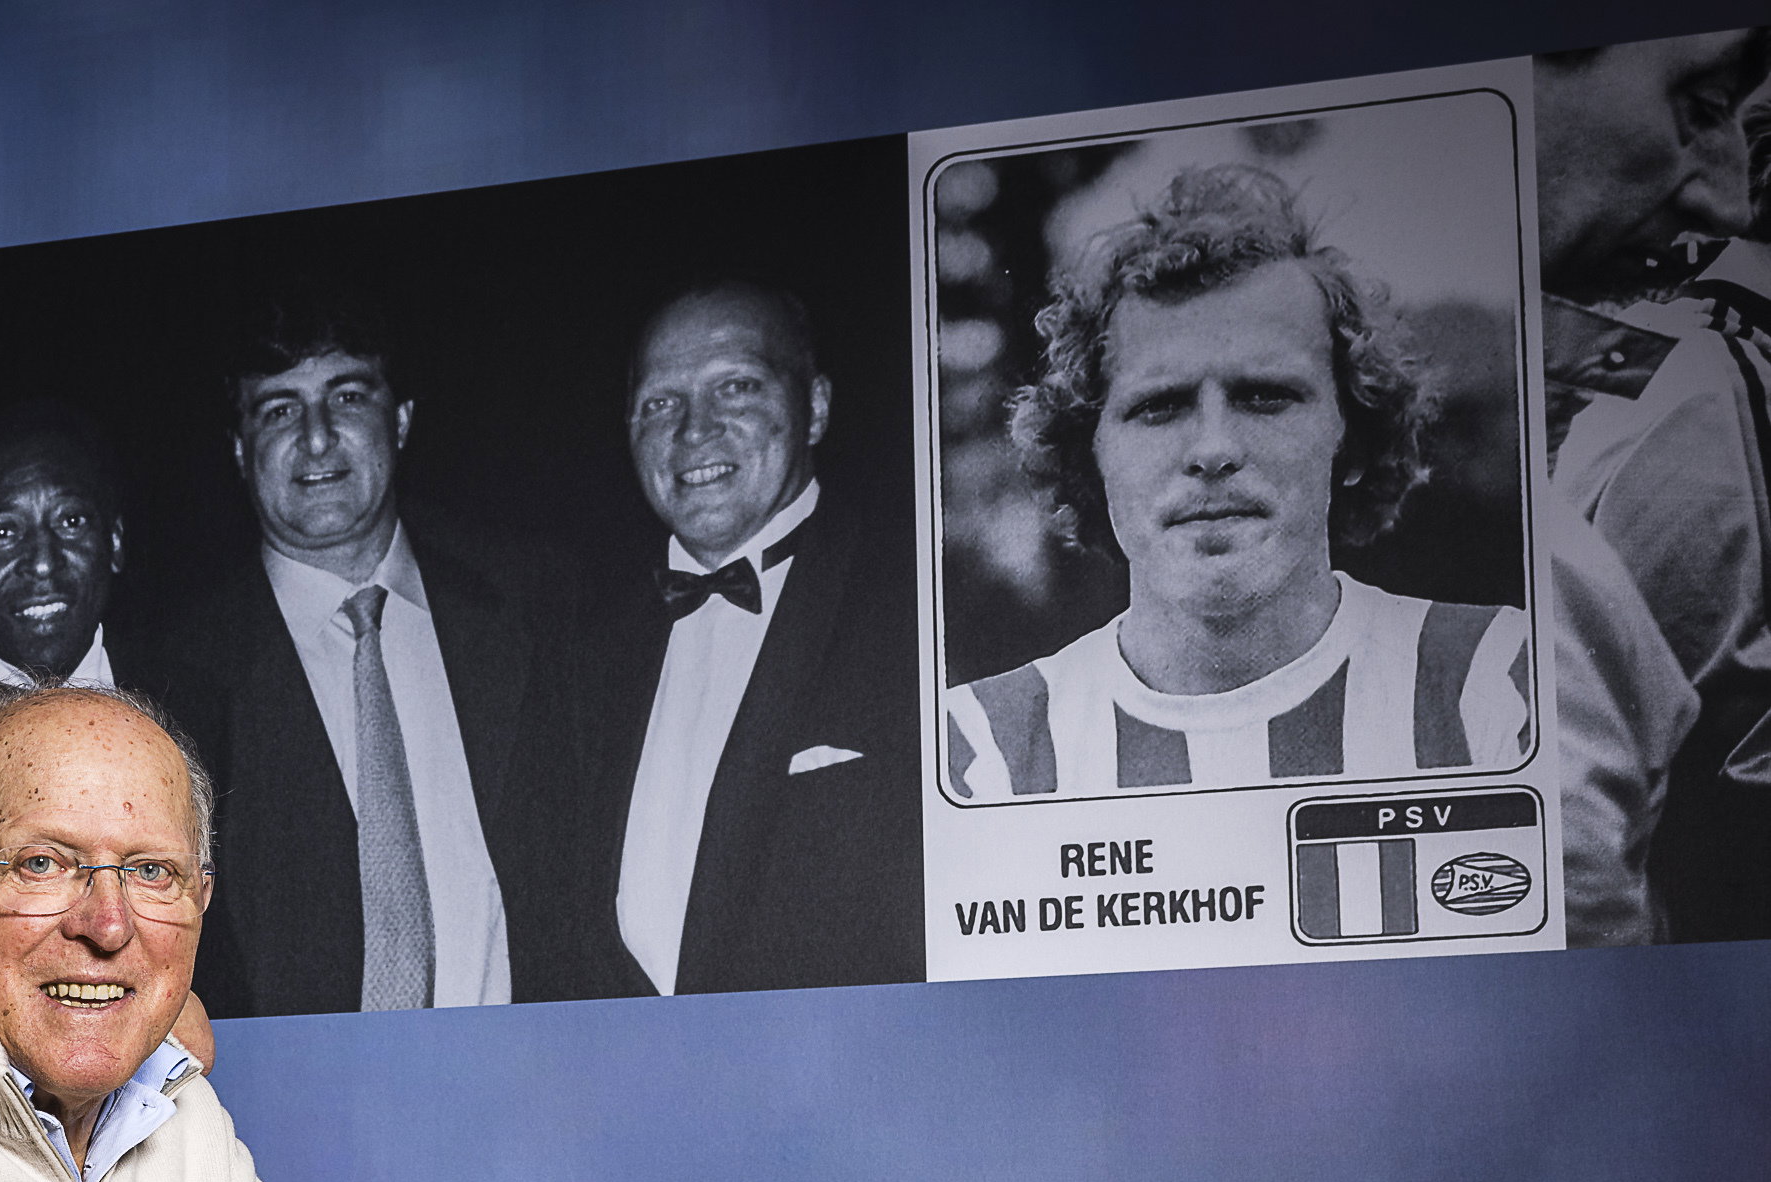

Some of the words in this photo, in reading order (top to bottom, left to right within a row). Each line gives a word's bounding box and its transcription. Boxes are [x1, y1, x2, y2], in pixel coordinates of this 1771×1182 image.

[1060, 839, 1154, 879] RENE
[954, 899, 1027, 936] VAN
[1038, 895, 1085, 932] DE
[1096, 885, 1266, 928] KERKHOF
